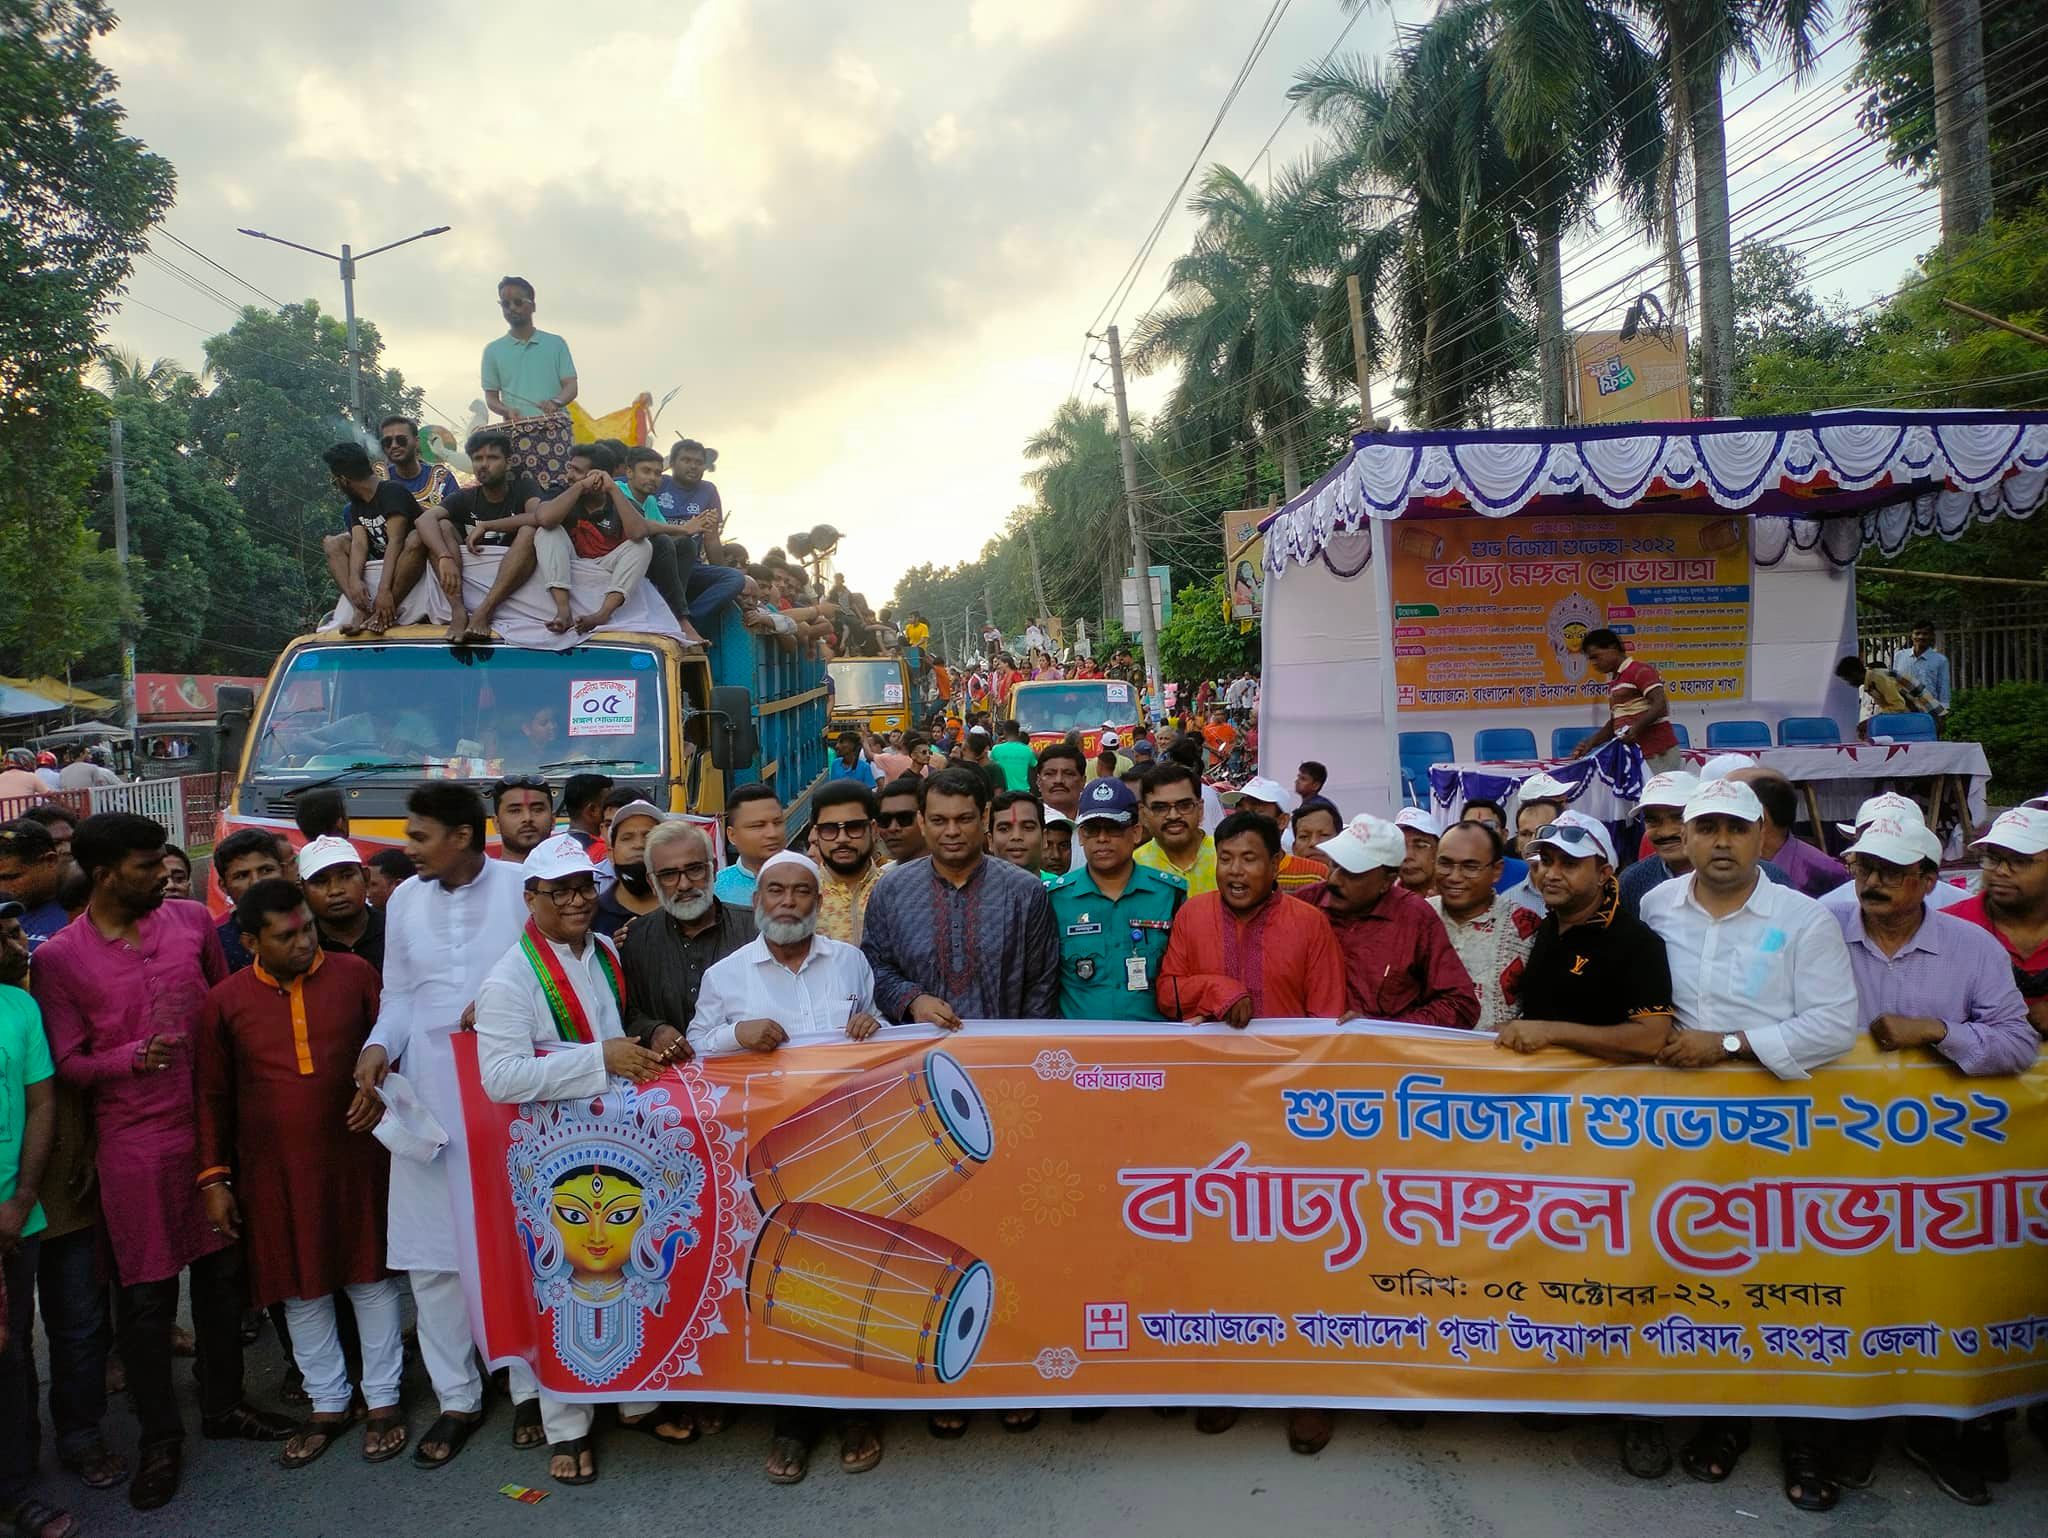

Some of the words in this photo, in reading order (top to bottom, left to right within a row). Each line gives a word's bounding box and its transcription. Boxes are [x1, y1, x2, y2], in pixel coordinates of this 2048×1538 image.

[1471, 541, 1502, 558] শুভ
[1507, 534, 1558, 558] বিজয়া
[1425, 557, 1503, 596] বর্ণাঢ্য
[1507, 560, 1582, 587] মঙ্গল
[1586, 558, 1717, 592] শোভাযাত্রা
[583, 695, 622, 714] ০৫
[1472, 686, 1515, 704] বাংলাদেশ
[1518, 684, 1537, 705] পূজা
[1680, 679, 1714, 694] মহানগর
[1074, 1066, 1100, 1090] ধর্ম
[1101, 1071, 1132, 1091] যার
[1134, 1070, 1165, 1090] যার
[1282, 1089, 1385, 1140] শুভ
[1394, 1073, 1573, 1152] বিজয়া
[1580, 1091, 2009, 1154] শুভেচ্ছা-২০২২
[1117, 1141, 1370, 1273] বর্ণাঢ্য
[1376, 1168, 1636, 1256] মঙ্গল
[1483, 1281, 1528, 1302] ০৫
[1742, 1282, 1846, 1310] বুধবার
[1294, 1308, 1431, 1350] বাংলাদেশ
[1437, 1313, 1500, 1362] পূজা
[1642, 1313, 1754, 1361] পরিষদ,
[1760, 1323, 1853, 1366] রংপুর
[1861, 1319, 1945, 1358] জেলা
[1950, 1326, 1979, 1356] ও
